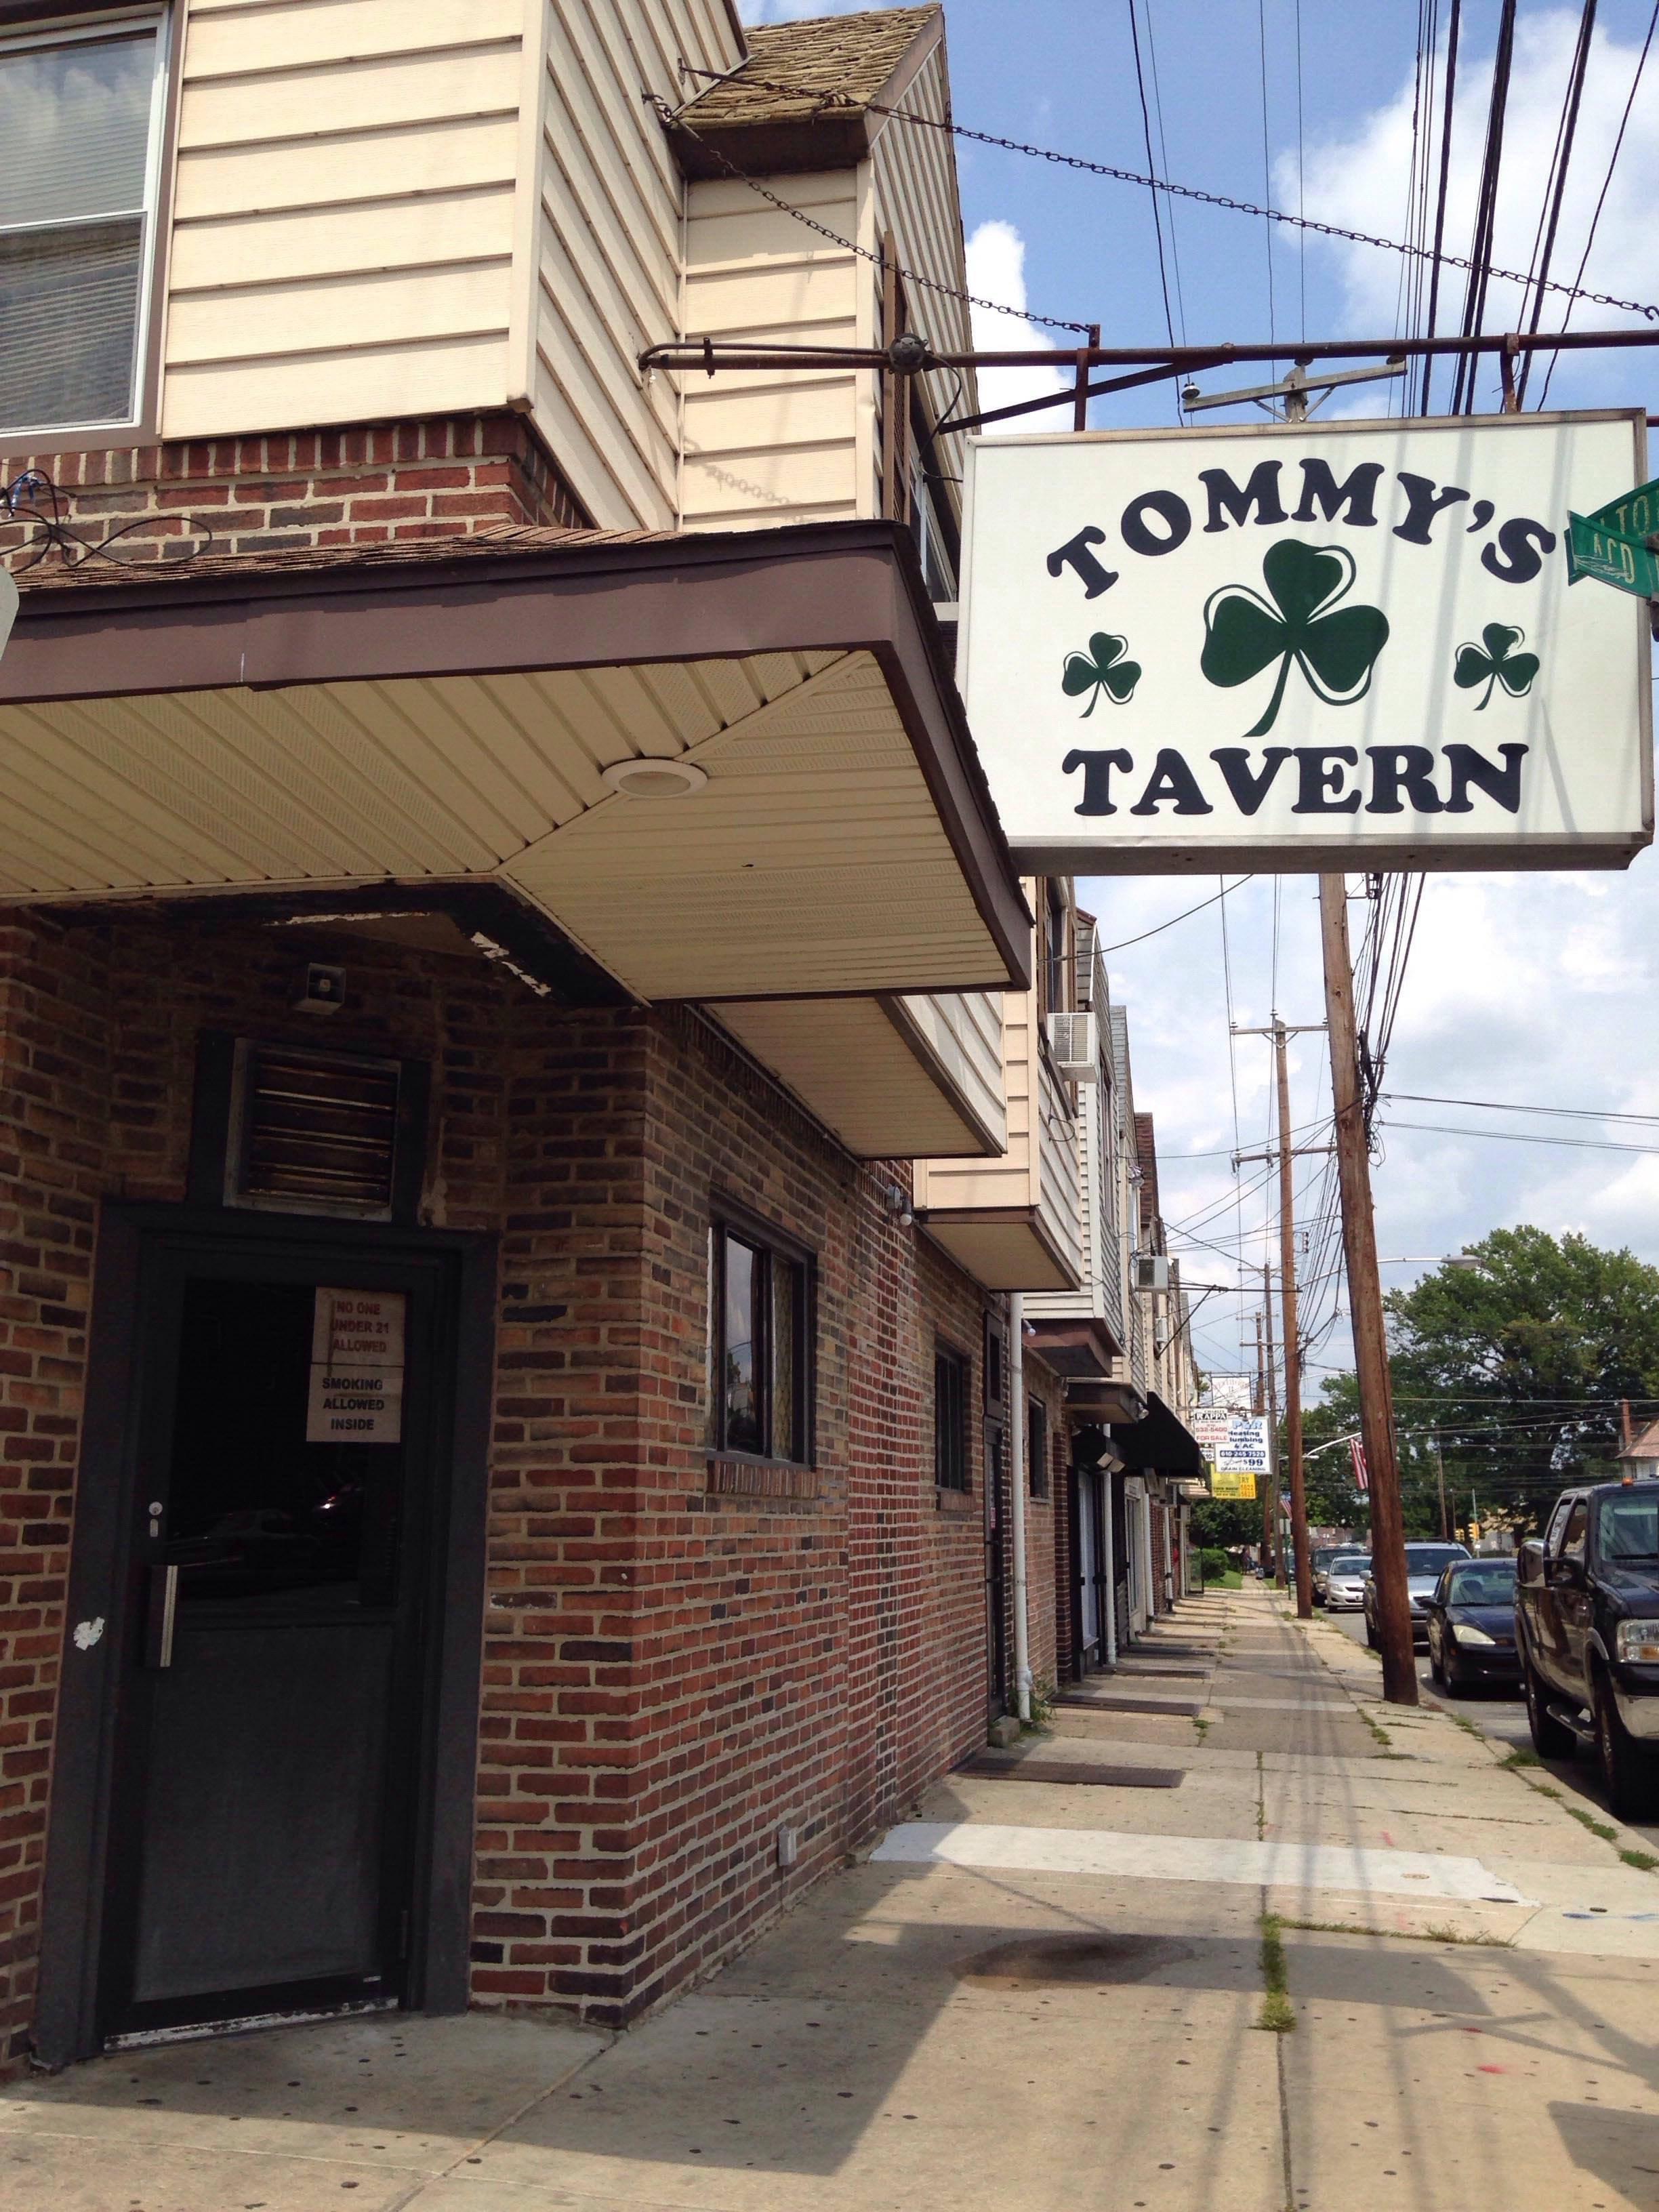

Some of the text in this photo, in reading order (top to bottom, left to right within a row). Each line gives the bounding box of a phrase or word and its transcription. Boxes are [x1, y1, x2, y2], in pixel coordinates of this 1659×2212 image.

[1046, 457, 1557, 600] TOMMY'S
[1061, 742, 1530, 817] TAVERN
[336, 1300, 381, 1315] NO ONE
[330, 1321, 390, 1334] UNDER 21
[333, 1339, 387, 1353] ALLOWED
[322, 1377, 384, 1391] SMOKING
[323, 1398, 385, 1411] ALLOWED
[331, 1418, 375, 1431] INSIDE
